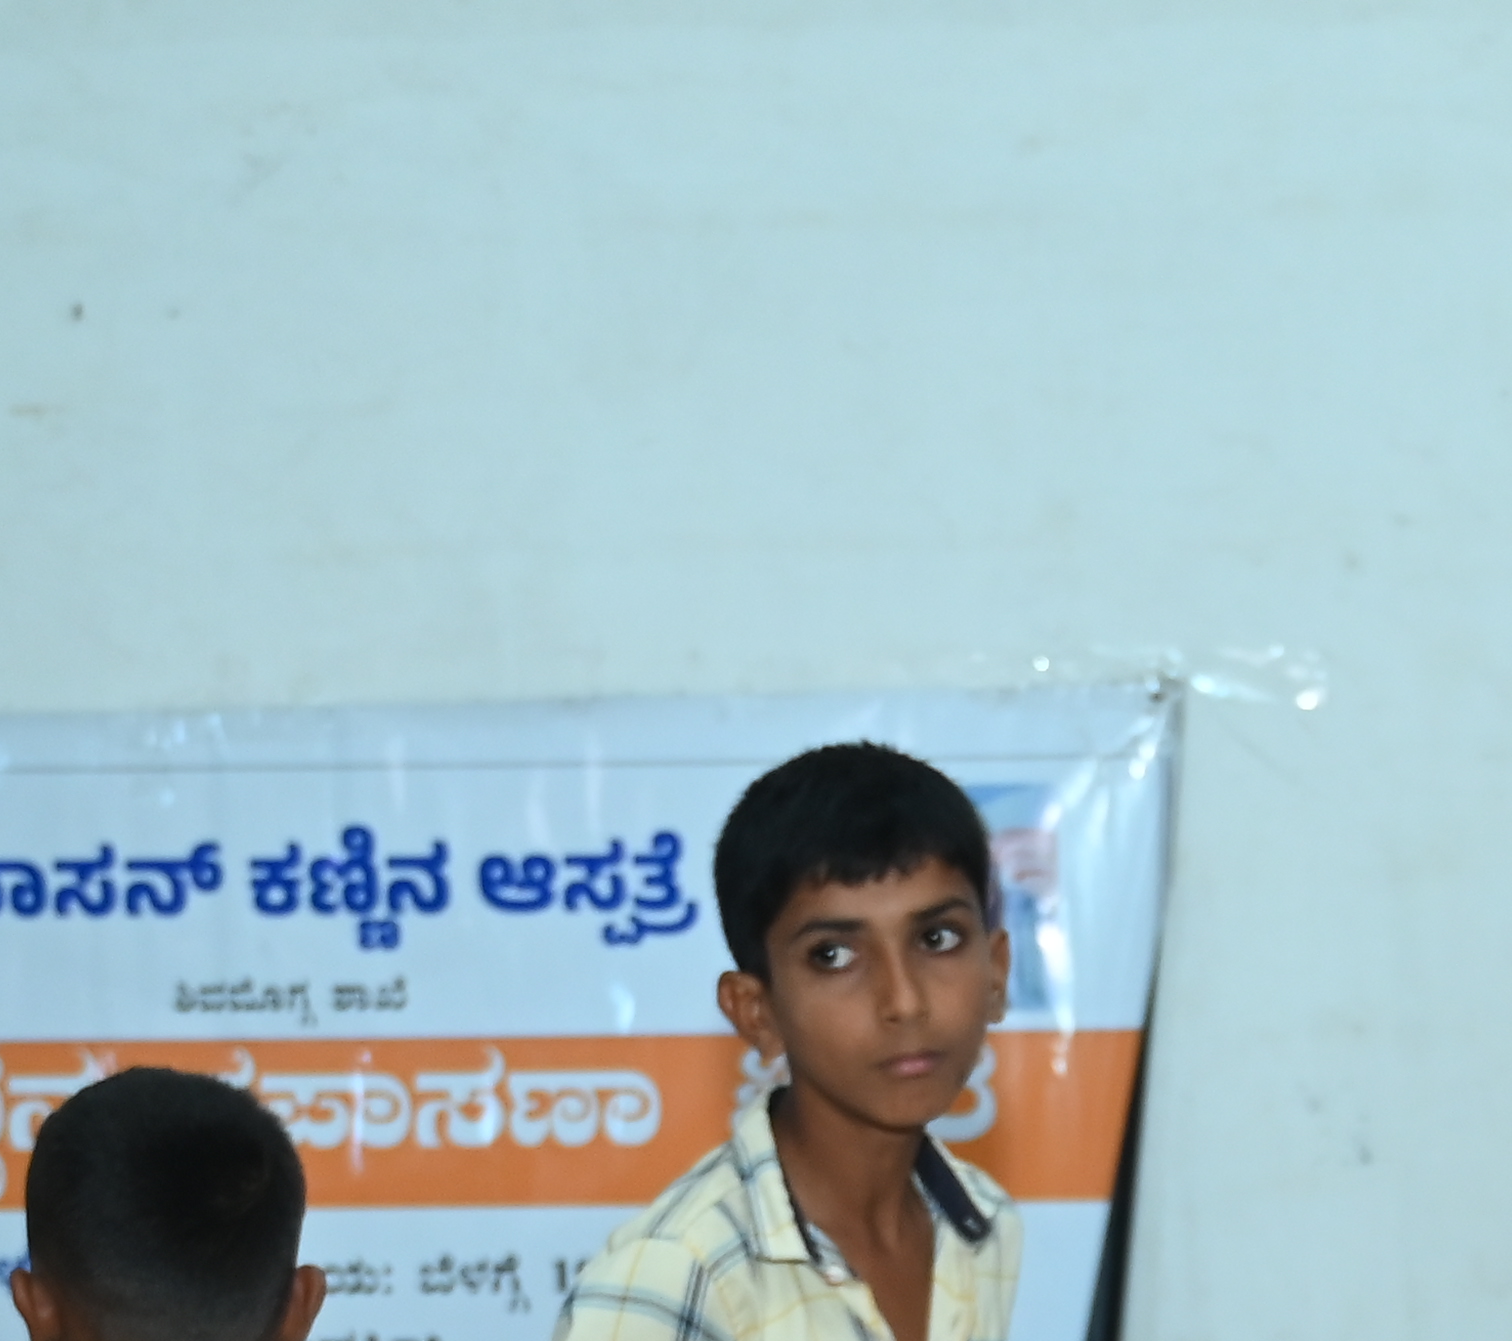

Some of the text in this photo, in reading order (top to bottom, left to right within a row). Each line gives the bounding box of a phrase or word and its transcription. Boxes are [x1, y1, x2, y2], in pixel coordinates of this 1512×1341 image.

[251, 824, 449, 949] ಕಣ್ಣಿನ
[479, 828, 700, 946] ಆಸ್ಪತ್ರೆ
[218, 1046, 663, 1149] ಪಾಸಣಾ
